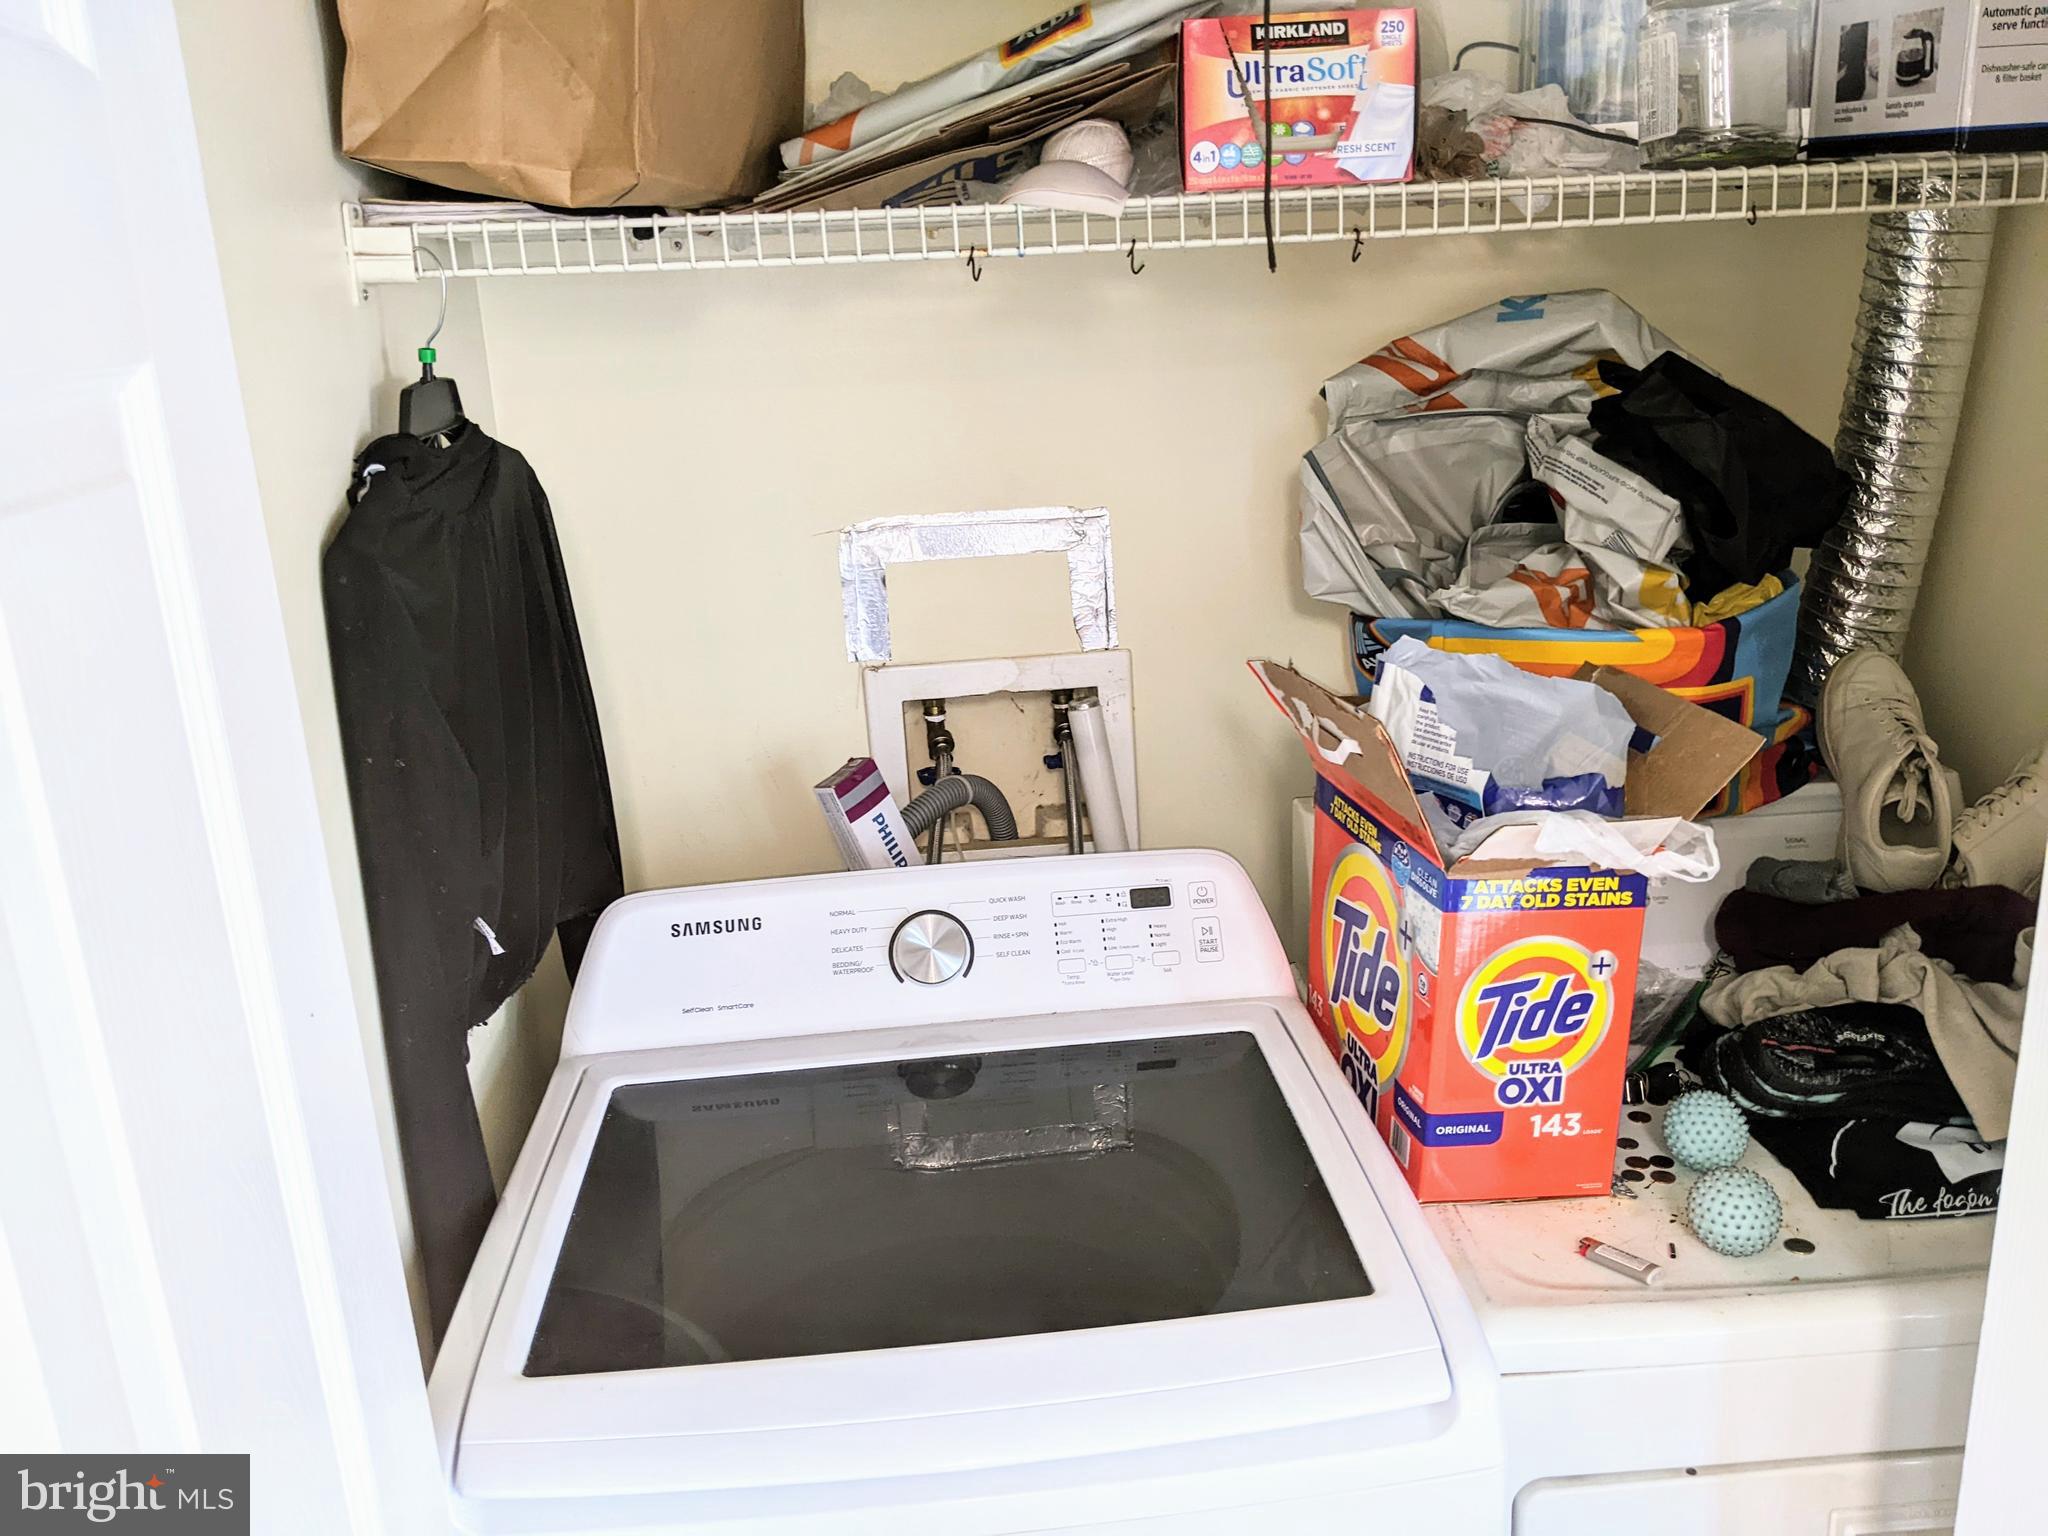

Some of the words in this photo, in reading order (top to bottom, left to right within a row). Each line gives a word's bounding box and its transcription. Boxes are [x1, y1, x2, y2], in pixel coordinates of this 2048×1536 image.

[1982, 5, 2032, 17] Automatic
[1381, 20, 1405, 33] 250
[1992, 21, 2017, 31] serve
[1333, 143, 1363, 154] RESH
[1364, 142, 1396, 152] SCENT
[1408, 752, 1444, 768] INSTRUCTIONS
[1445, 762, 1457, 771] FOR
[1457, 766, 1469, 775] USE
[1334, 795, 1360, 823] ATTACKS
[1360, 815, 1378, 839] EVEN
[1334, 805, 1346, 824] DAY
[1346, 816, 1359, 835] OLD
[1359, 827, 1382, 855] STAINS
[872, 812, 908, 868] PHILIP
[1417, 867, 1438, 889] CLEAN
[1473, 878, 1562, 895] ATTACKS
[1566, 876, 1619, 892] EVEN
[1461, 895, 1473, 910] 7
[1477, 894, 1517, 910] DAY
[1520, 893, 1560, 908] OLD
[1564, 891, 1632, 907] STAINS
[829, 909, 856, 917] NORMAL
[671, 916, 762, 938] SAMSUNG
[852, 926, 868, 934] DUTY
[832, 945, 864, 953] DELICATES
[1010, 949, 1031, 957] CLEAN
[833, 966, 875, 975] WATERPROOF
[1330, 897, 1401, 1031] Tide
[717, 1002, 755, 1011] SmartCare
[1477, 977, 1594, 1060] Tide
[1347, 1032, 1378, 1087] ULTRA
[1509, 1062, 1562, 1075] ULTRA
[1498, 1076, 1563, 1105] OXI
[1396, 1096, 1422, 1129] ORIGINAL
[1435, 1123, 1492, 1135] ORIGINAL
[1530, 1112, 1582, 1138] 143
[1878, 1188, 1927, 1217] The
